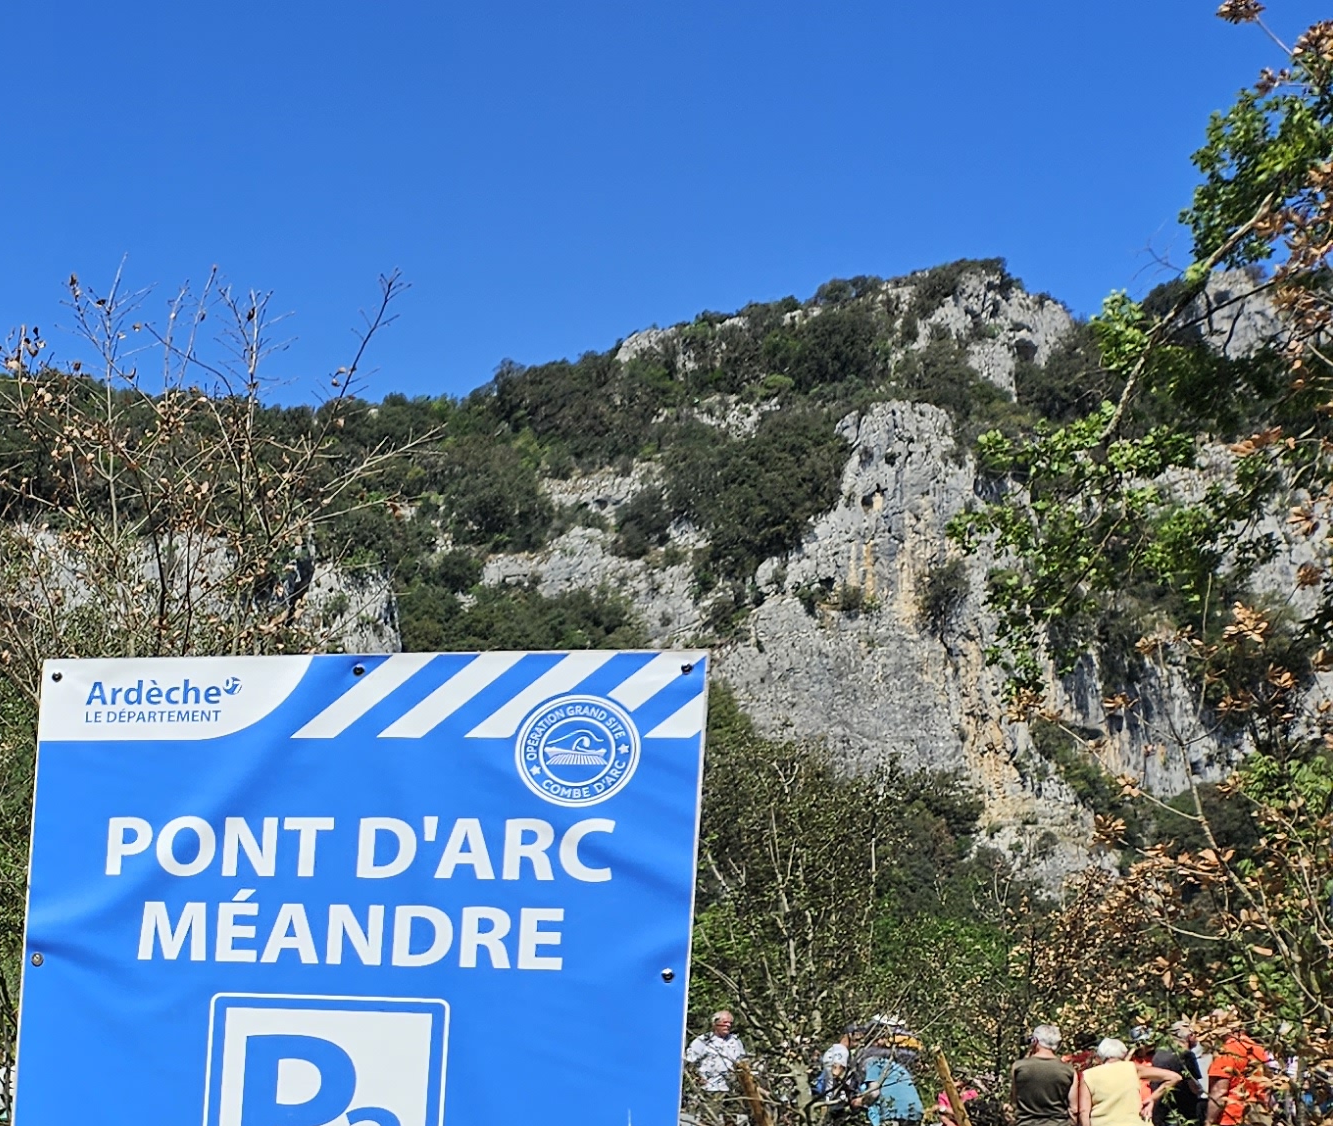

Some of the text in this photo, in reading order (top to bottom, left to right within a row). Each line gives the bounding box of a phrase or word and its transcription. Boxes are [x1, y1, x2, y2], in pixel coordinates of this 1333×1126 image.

[85, 679, 222, 706] Ardèche
[85, 708, 221, 723] LE DÉPARTEMENT
[566, 705, 608, 721] GRAND
[606, 717, 626, 739] SITE
[541, 760, 626, 798] COMBE D'ARC
[105, 815, 616, 883] PONT D'ARC
[137, 888, 565, 971] MÉANDRE
